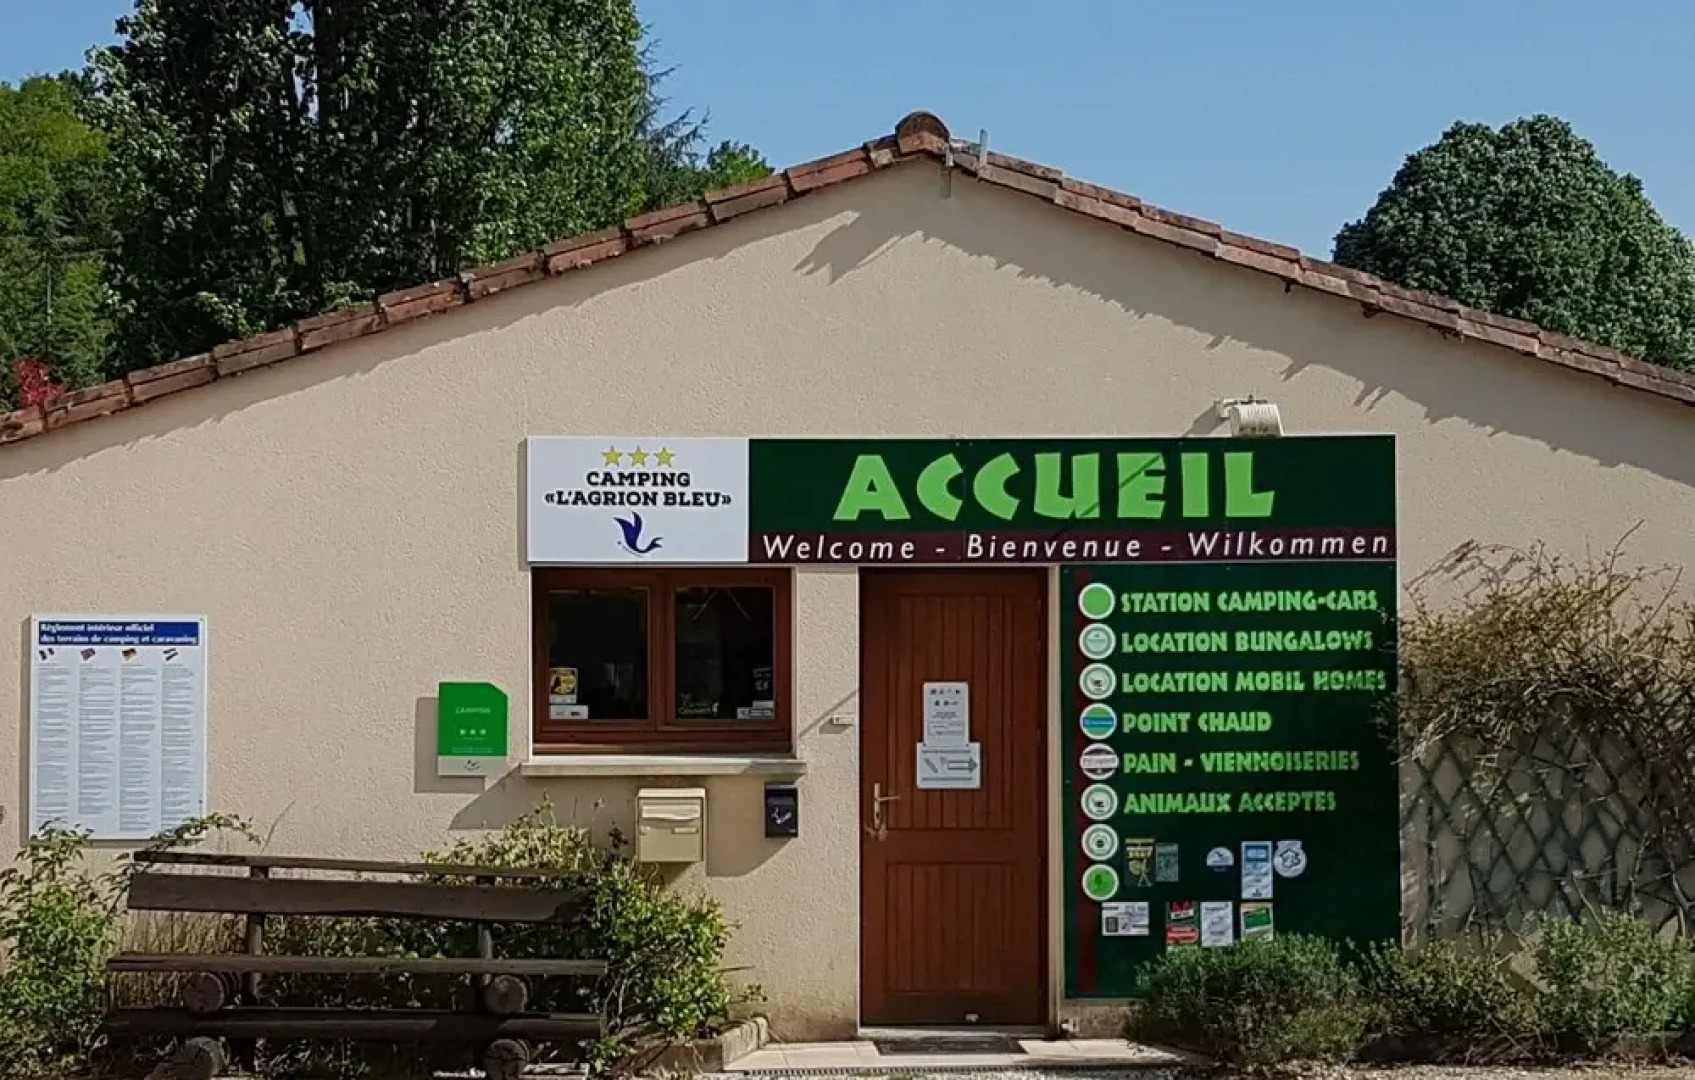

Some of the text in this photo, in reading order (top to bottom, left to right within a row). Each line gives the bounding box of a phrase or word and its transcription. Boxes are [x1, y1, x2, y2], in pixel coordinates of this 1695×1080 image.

[586, 472, 691, 487] CAMPING
[833, 452, 1275, 521] ACCUEIL
[663, 491, 731, 507] BLEU»
[763, 535, 915, 559] Welcome
[967, 533, 1140, 558] Bienvenue
[1188, 532, 1387, 556] Wilkommen
[1121, 590, 1378, 613] STATION CAMPING-CARS
[1122, 630, 1373, 653] LOCATION BUNGALOWS
[1122, 670, 1386, 693] LOCATION MOBIL HOMES
[1122, 711, 1272, 733] POINT CHAUD
[1123, 752, 1176, 773] PAIN
[1199, 751, 1359, 773] VIENNOISERIES
[1123, 791, 1336, 813] ANIMAUX ACCEPTES
